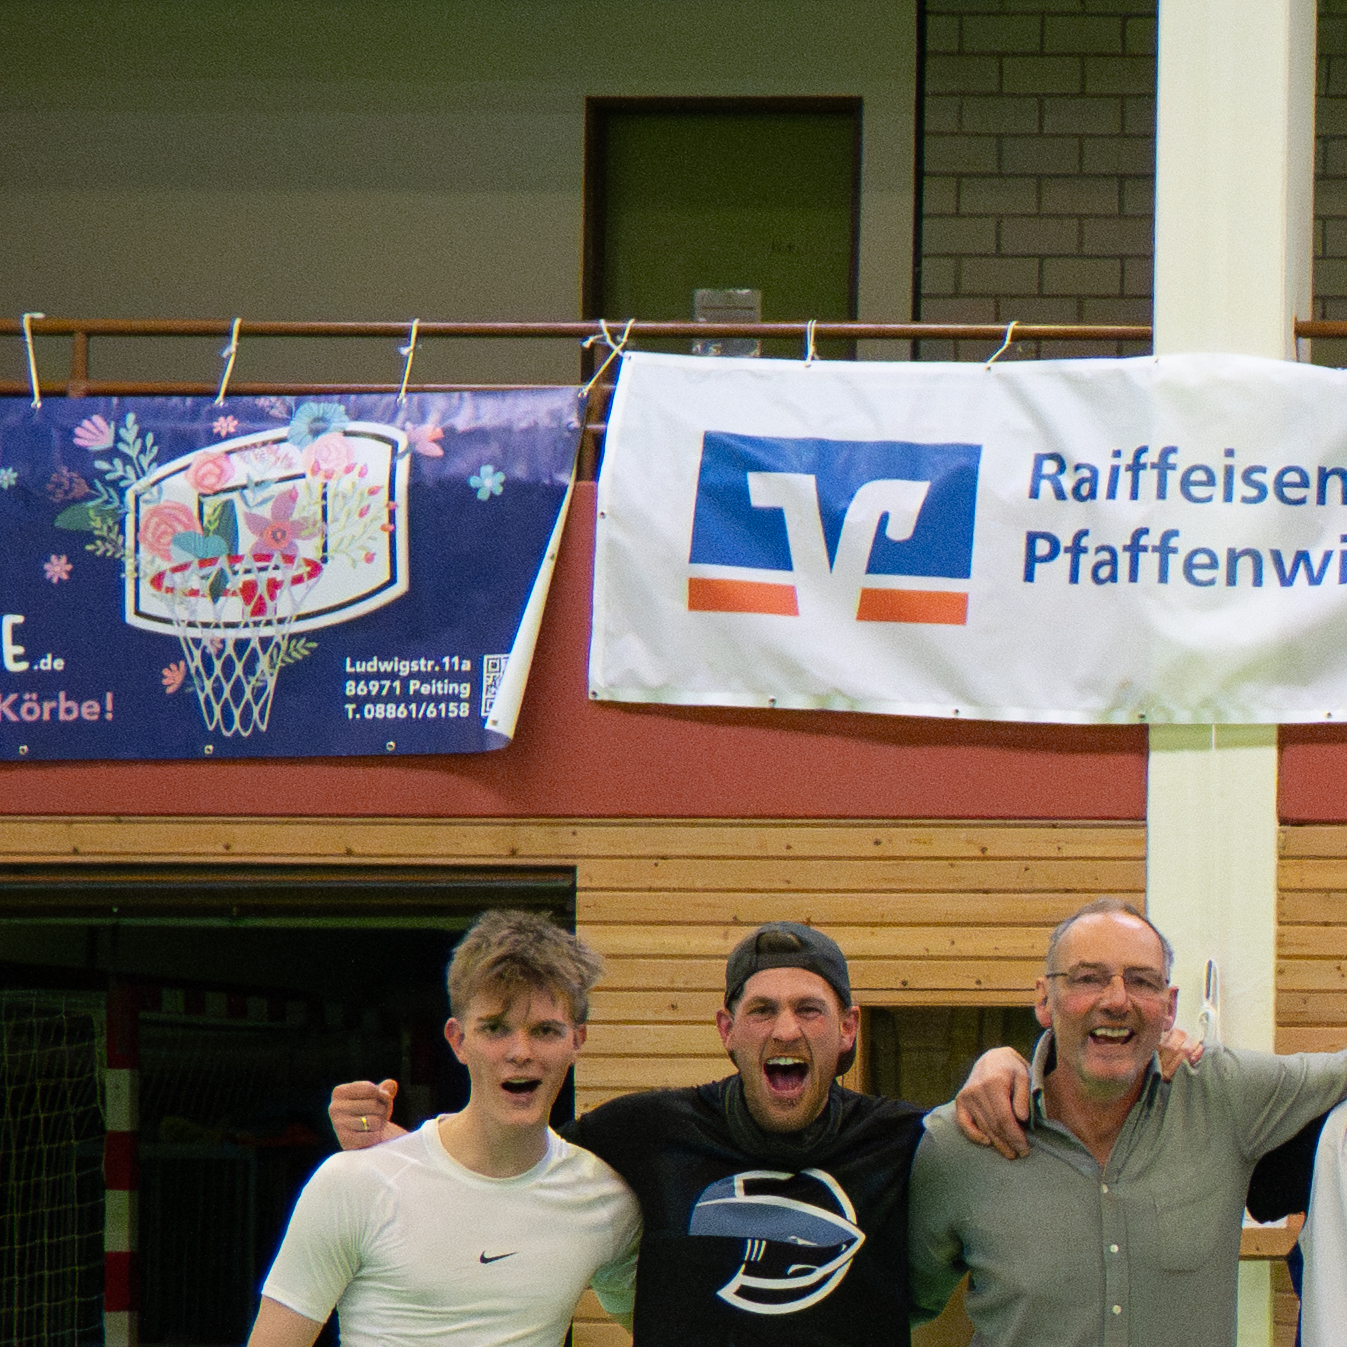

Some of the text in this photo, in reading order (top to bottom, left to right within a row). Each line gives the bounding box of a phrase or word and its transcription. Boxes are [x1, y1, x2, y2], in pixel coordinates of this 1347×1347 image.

[344, 679, 471, 699] 86971 Peiting
[363, 702, 470, 719] 08861/6158
